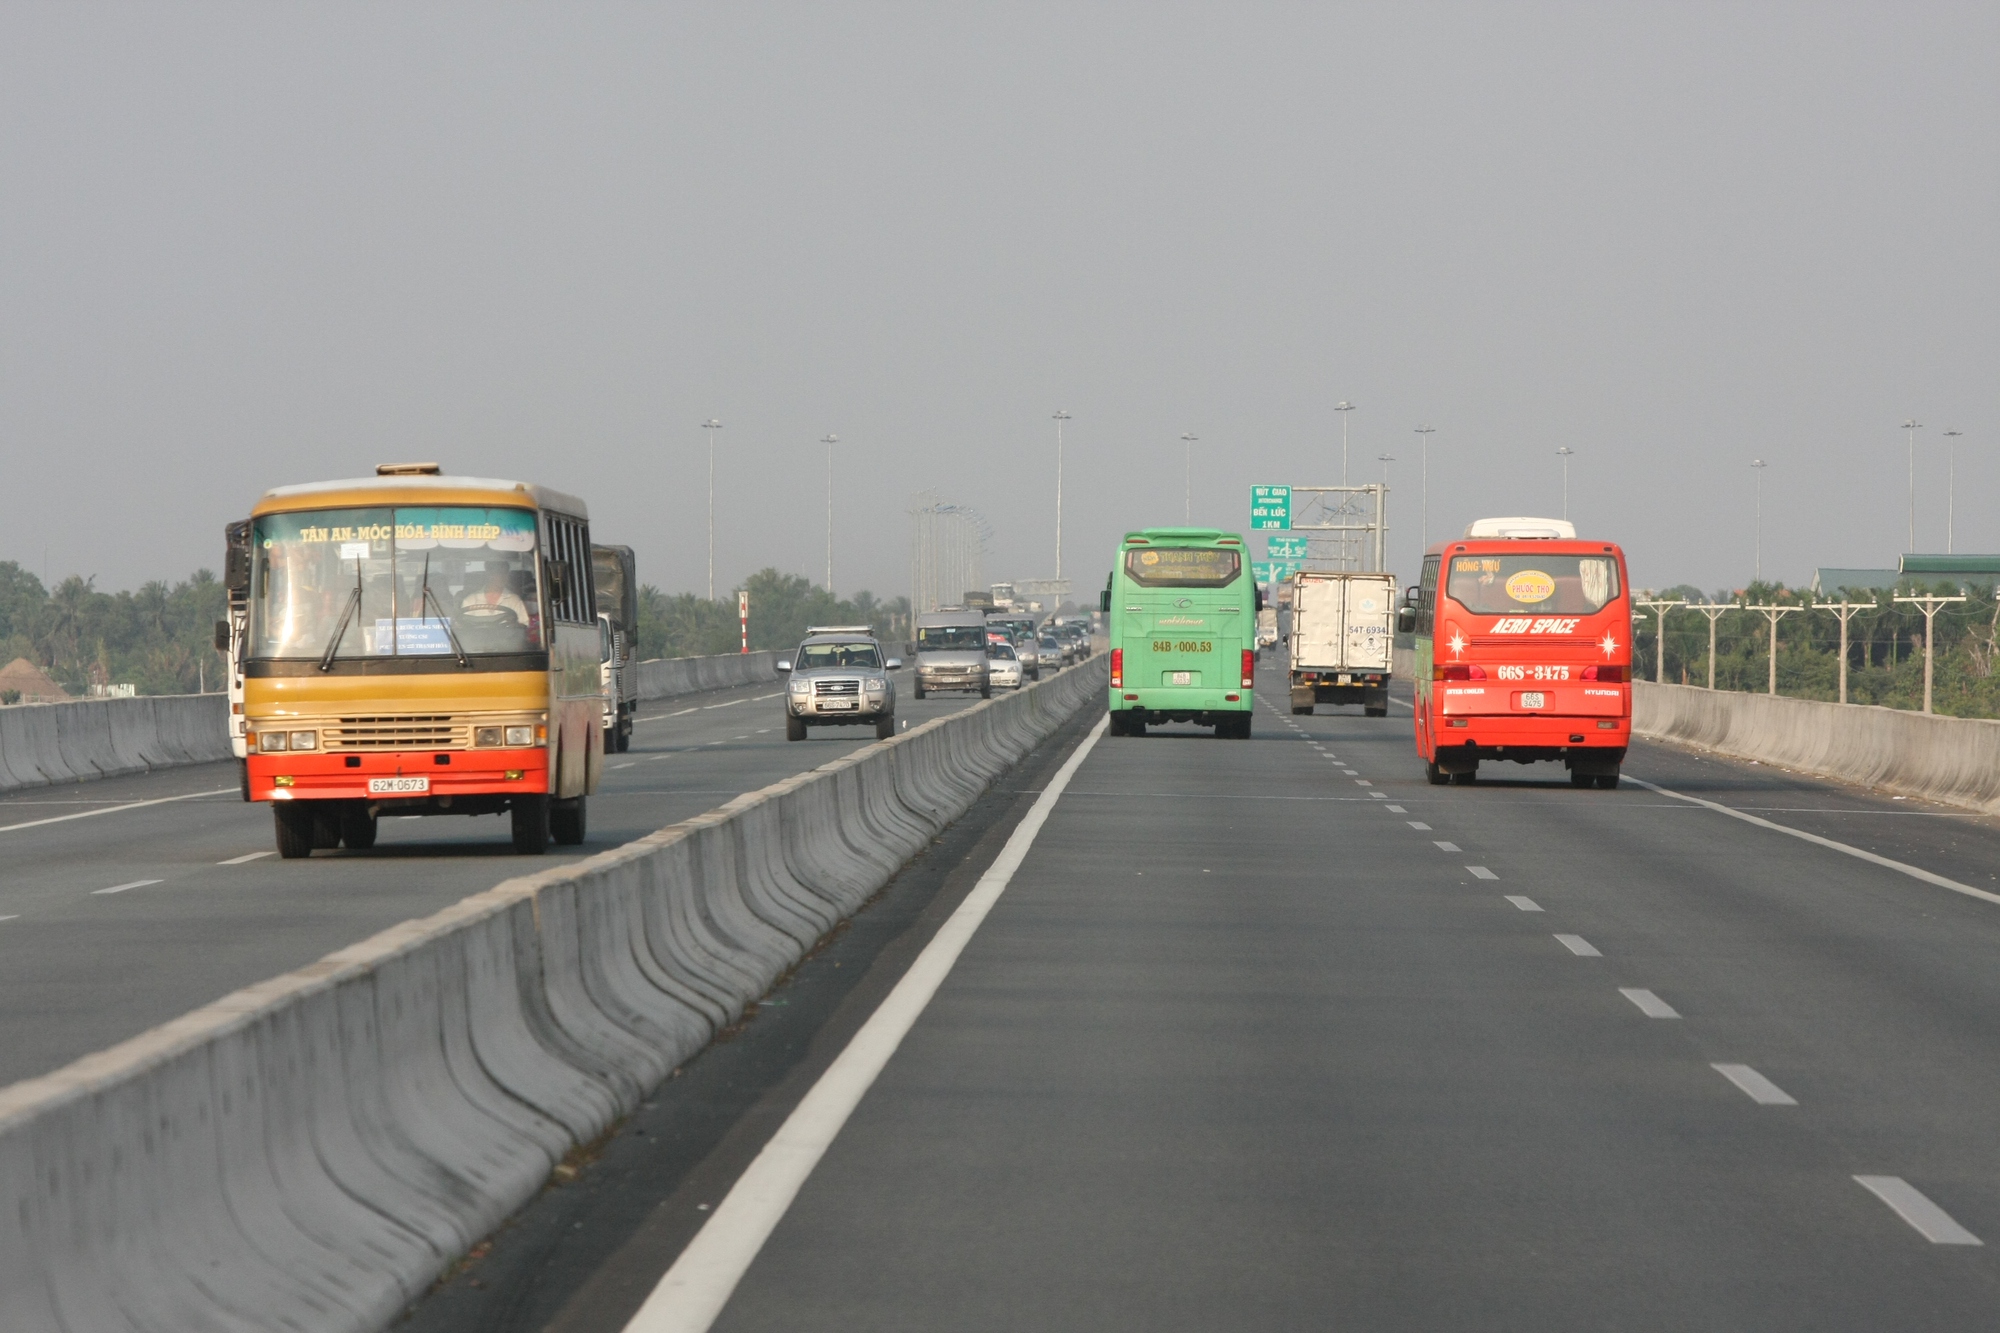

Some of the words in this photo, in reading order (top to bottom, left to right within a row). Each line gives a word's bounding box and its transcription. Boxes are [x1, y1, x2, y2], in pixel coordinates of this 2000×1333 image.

[1272, 488, 1287, 496] GIAO
[1253, 506, 1267, 516] BẾN
[1271, 506, 1286, 516] LỨC
[300, 525, 328, 542] TÂN
[467, 523, 500, 542] HIỆP
[1490, 618, 1533, 634] AERO
[1529, 619, 1580, 634] SPACE
[1584, 689, 1620, 697] HYUNDAI
